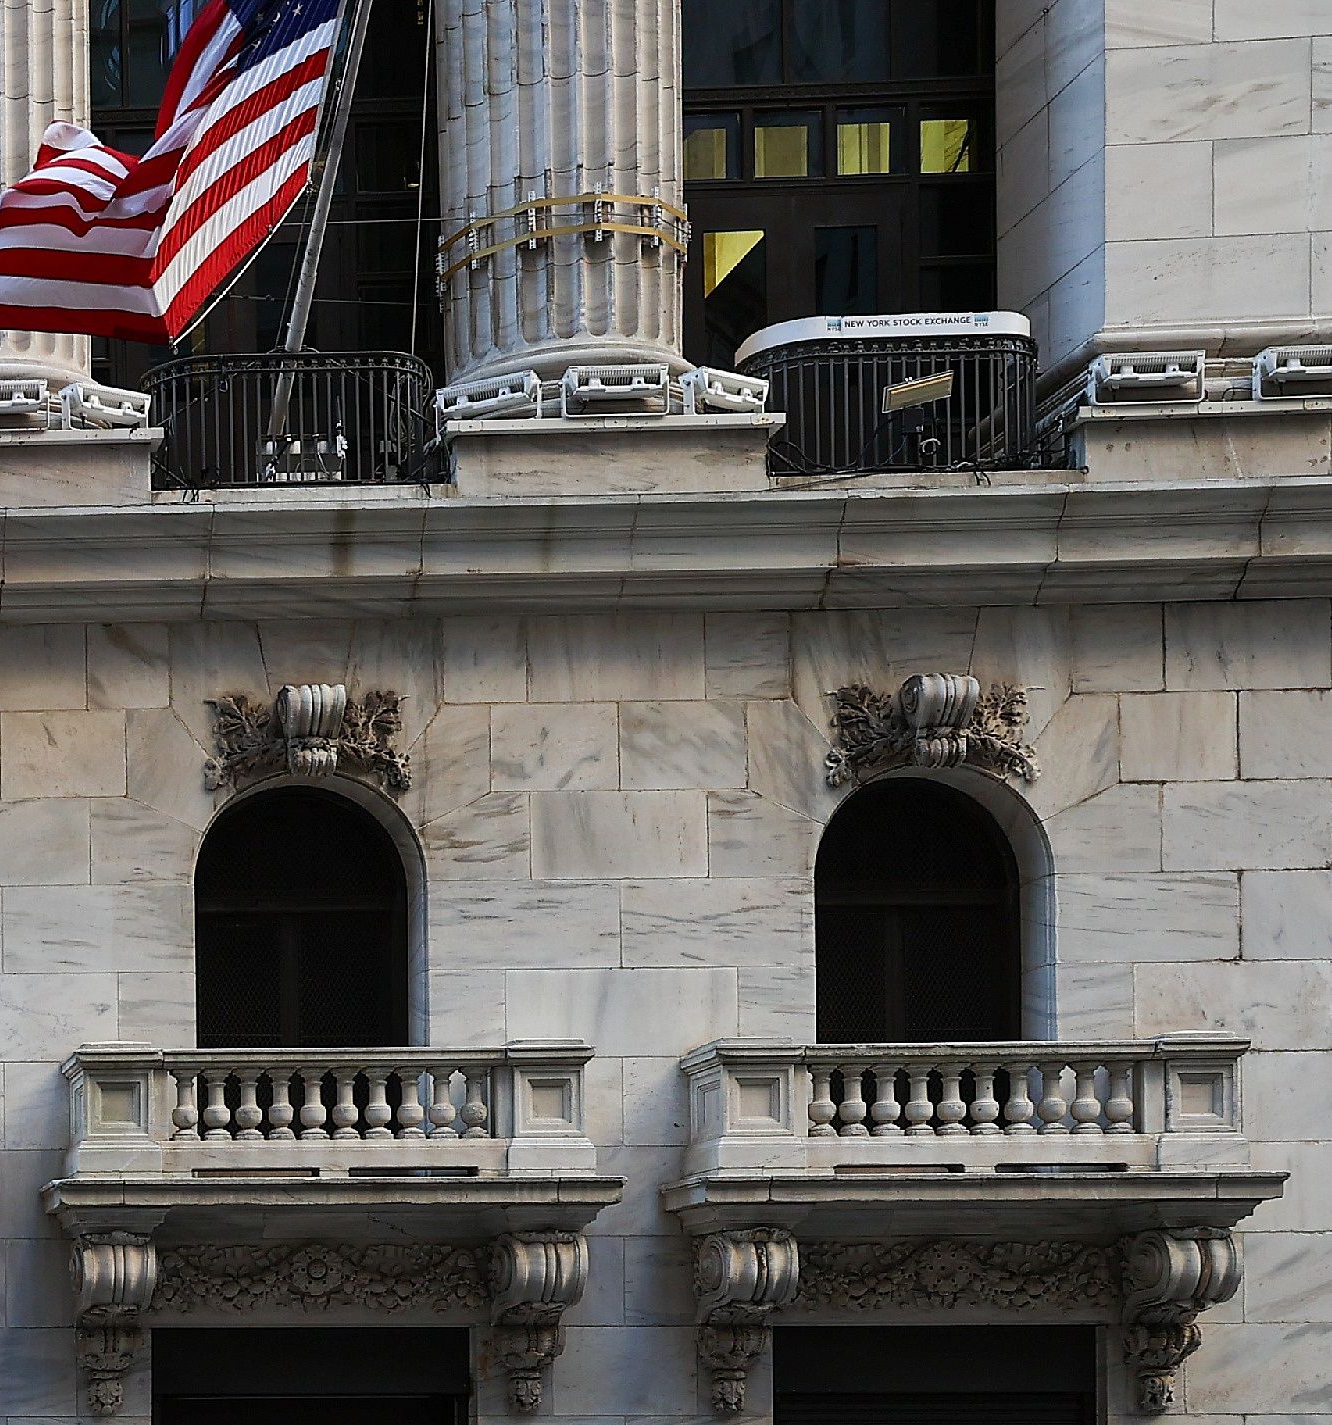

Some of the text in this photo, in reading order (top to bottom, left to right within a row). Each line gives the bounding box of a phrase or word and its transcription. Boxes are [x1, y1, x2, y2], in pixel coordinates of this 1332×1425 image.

[844, 316, 971, 328] NEW YORK STOCK EXCHANGE
